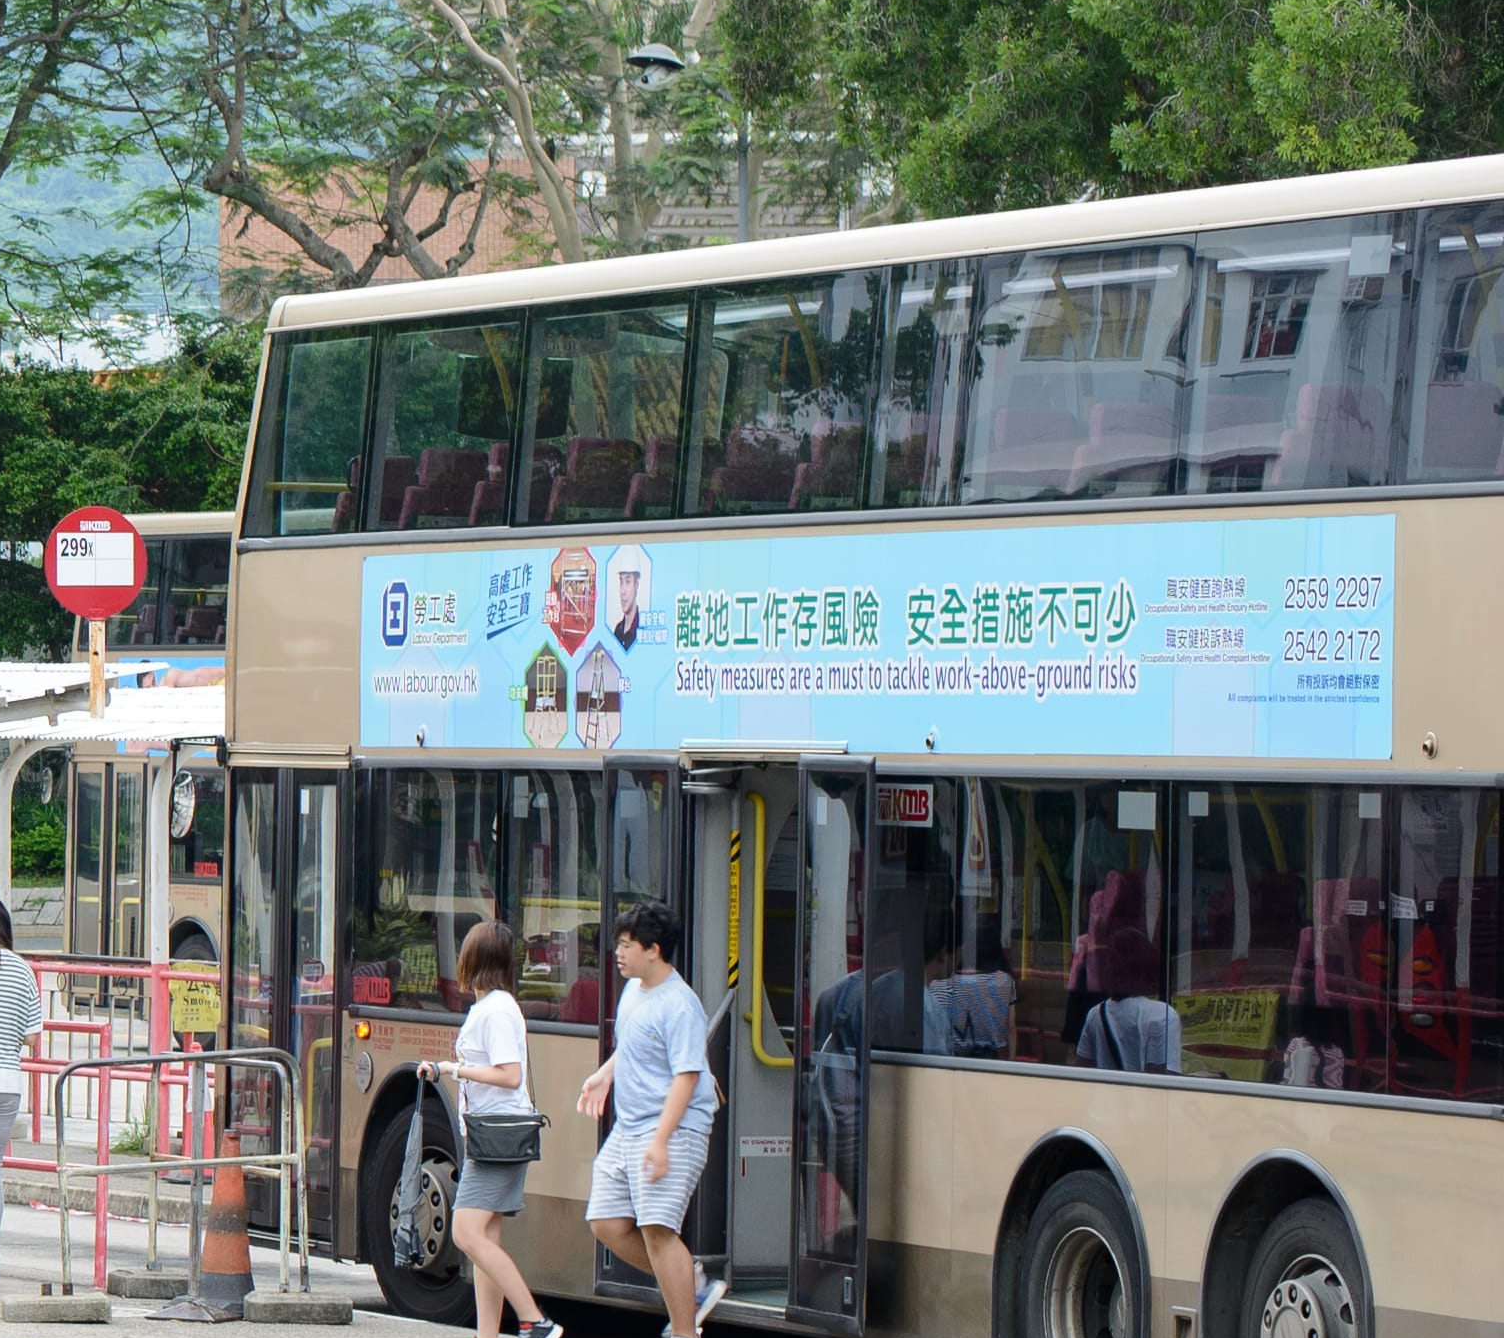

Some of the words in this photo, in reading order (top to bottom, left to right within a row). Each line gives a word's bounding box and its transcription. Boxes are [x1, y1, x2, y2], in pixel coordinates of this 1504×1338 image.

[60, 538, 94, 557] 299X
[489, 565, 533, 598] 高處工作
[1284, 577, 1329, 609] 2559
[1335, 577, 1382, 608] 2297
[414, 593, 456, 625] 勞工處
[487, 592, 531, 626] 安全三寶
[676, 589, 880, 648] 離地工作存風險
[907, 583, 1136, 646] 安全措施不可少
[412, 632, 431, 645] Labour
[432, 632, 468, 646] Department
[1283, 630, 1328, 662] 2542
[1334, 630, 1381, 661] 2172
[373, 669, 478, 698] www.labour.gov.hk
[676, 660, 717, 698] Safety
[721, 666, 785, 690] measures
[789, 666, 811, 690] are
[815, 668, 824, 690] a
[828, 662, 864, 689] must
[869, 662, 882, 689] to
[886, 657, 930, 689] tackle
[1098, 656, 1136, 689] risks
